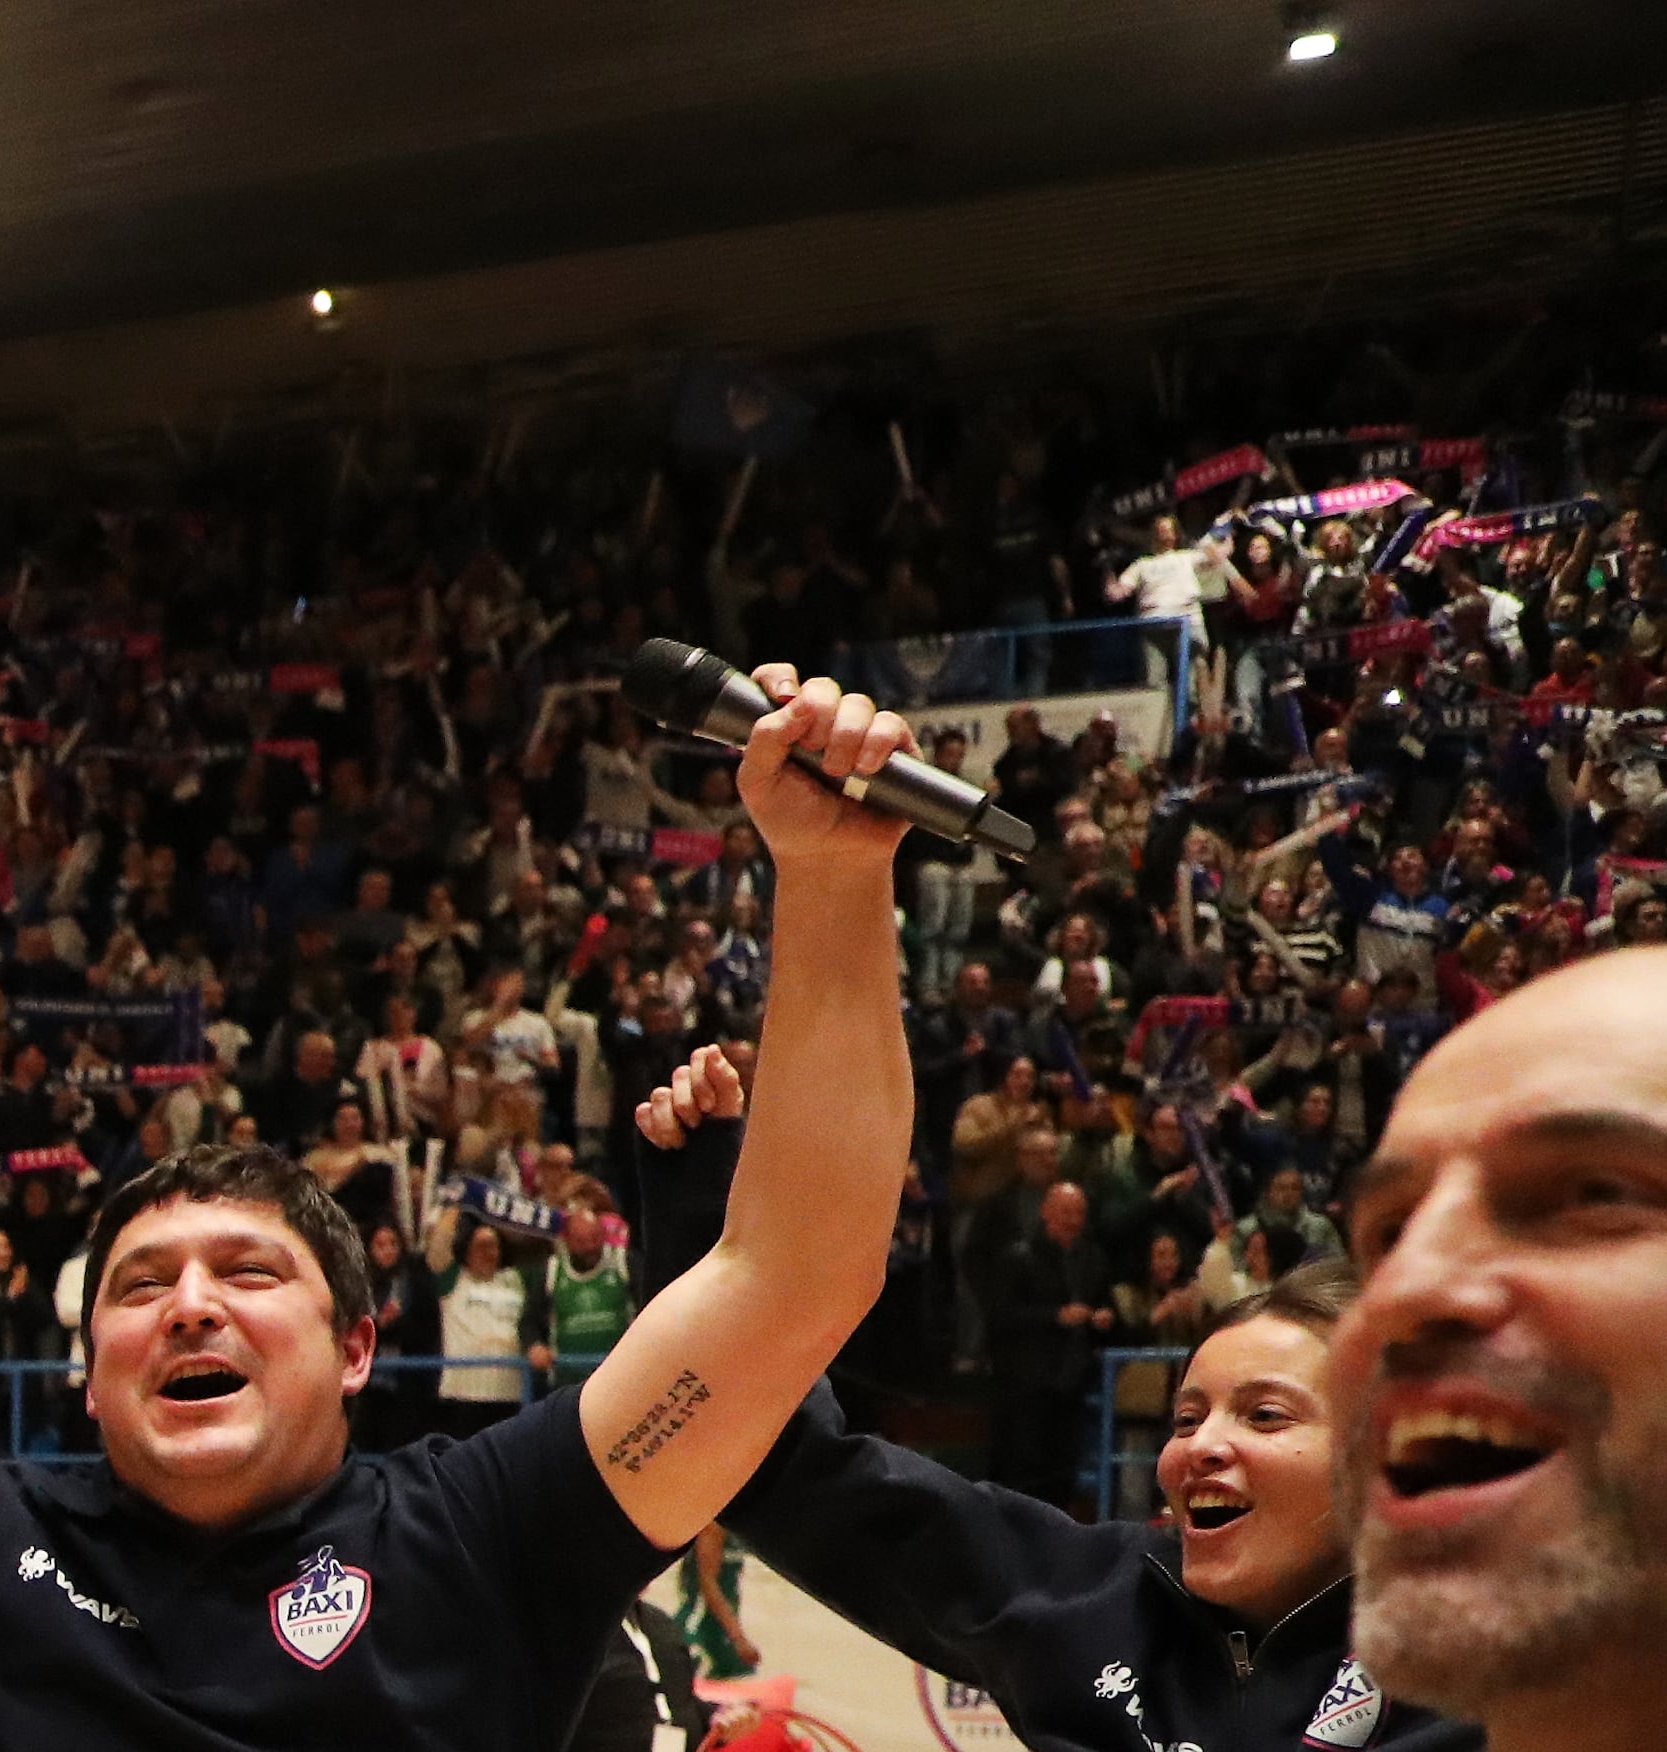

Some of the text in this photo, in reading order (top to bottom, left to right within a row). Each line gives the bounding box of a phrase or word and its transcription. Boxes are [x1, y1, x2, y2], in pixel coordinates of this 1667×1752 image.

[286, 1590, 354, 1621] BAXI
[292, 1623, 341, 1638] FERROL
[1319, 1707, 1372, 1736] FERROL
